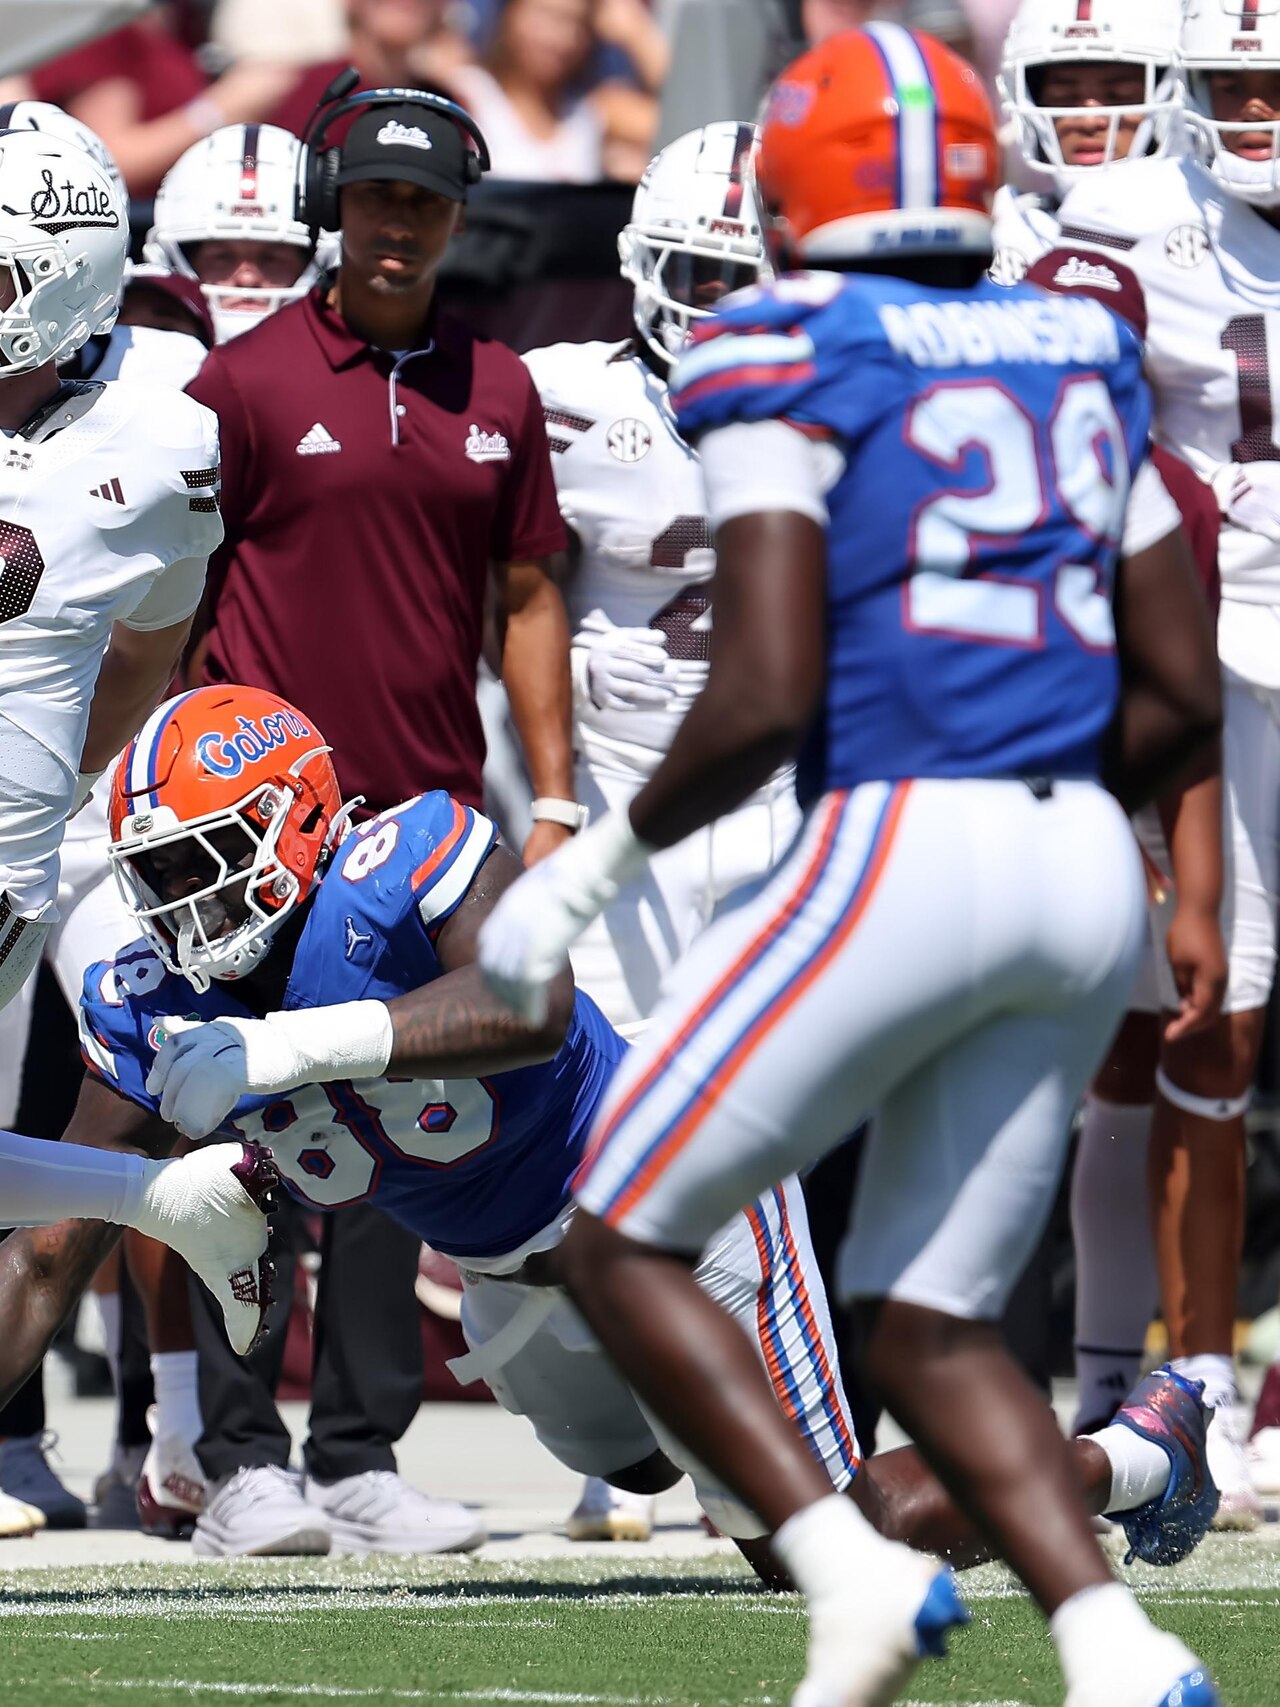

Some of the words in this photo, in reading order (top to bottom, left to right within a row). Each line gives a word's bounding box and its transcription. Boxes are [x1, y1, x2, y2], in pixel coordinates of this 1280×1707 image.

[376, 119, 433, 150] State
[28, 169, 119, 236] State
[1165, 224, 1211, 269] SEC
[1053, 256, 1122, 292] State
[465, 423, 511, 463] State
[606, 418, 652, 463] SEC
[902, 371, 1132, 655] 29
[196, 707, 311, 779] Gators
